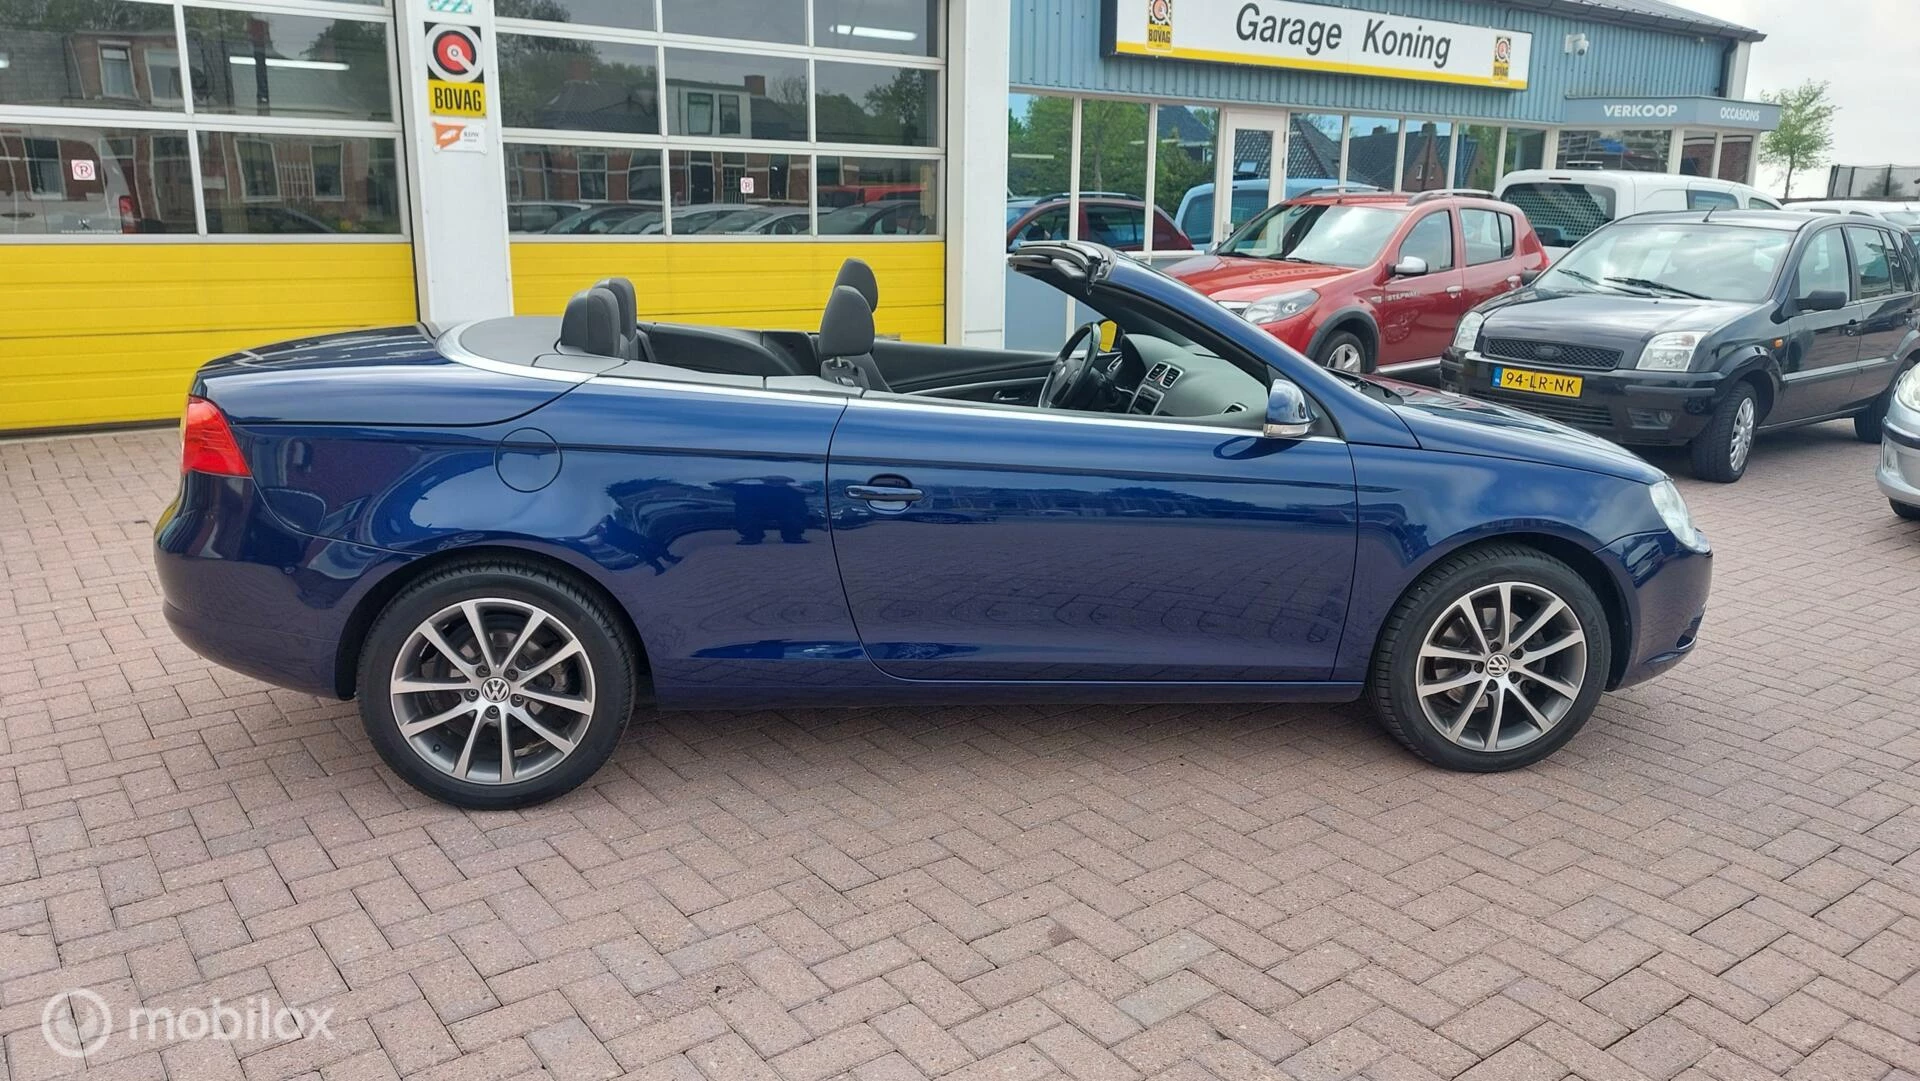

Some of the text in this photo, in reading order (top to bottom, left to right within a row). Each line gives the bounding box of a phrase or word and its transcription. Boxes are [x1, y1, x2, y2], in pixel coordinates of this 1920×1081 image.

[1148, 29, 1171, 44] BOVAG
[1236, 2, 1451, 69] Garage Koning
[434, 87, 482, 112] BOVAG
[1603, 104, 1678, 118] VERKOOP
[1720, 106, 1760, 122] OCCASIONS
[1506, 371, 1575, 394] 94-LR-NK
